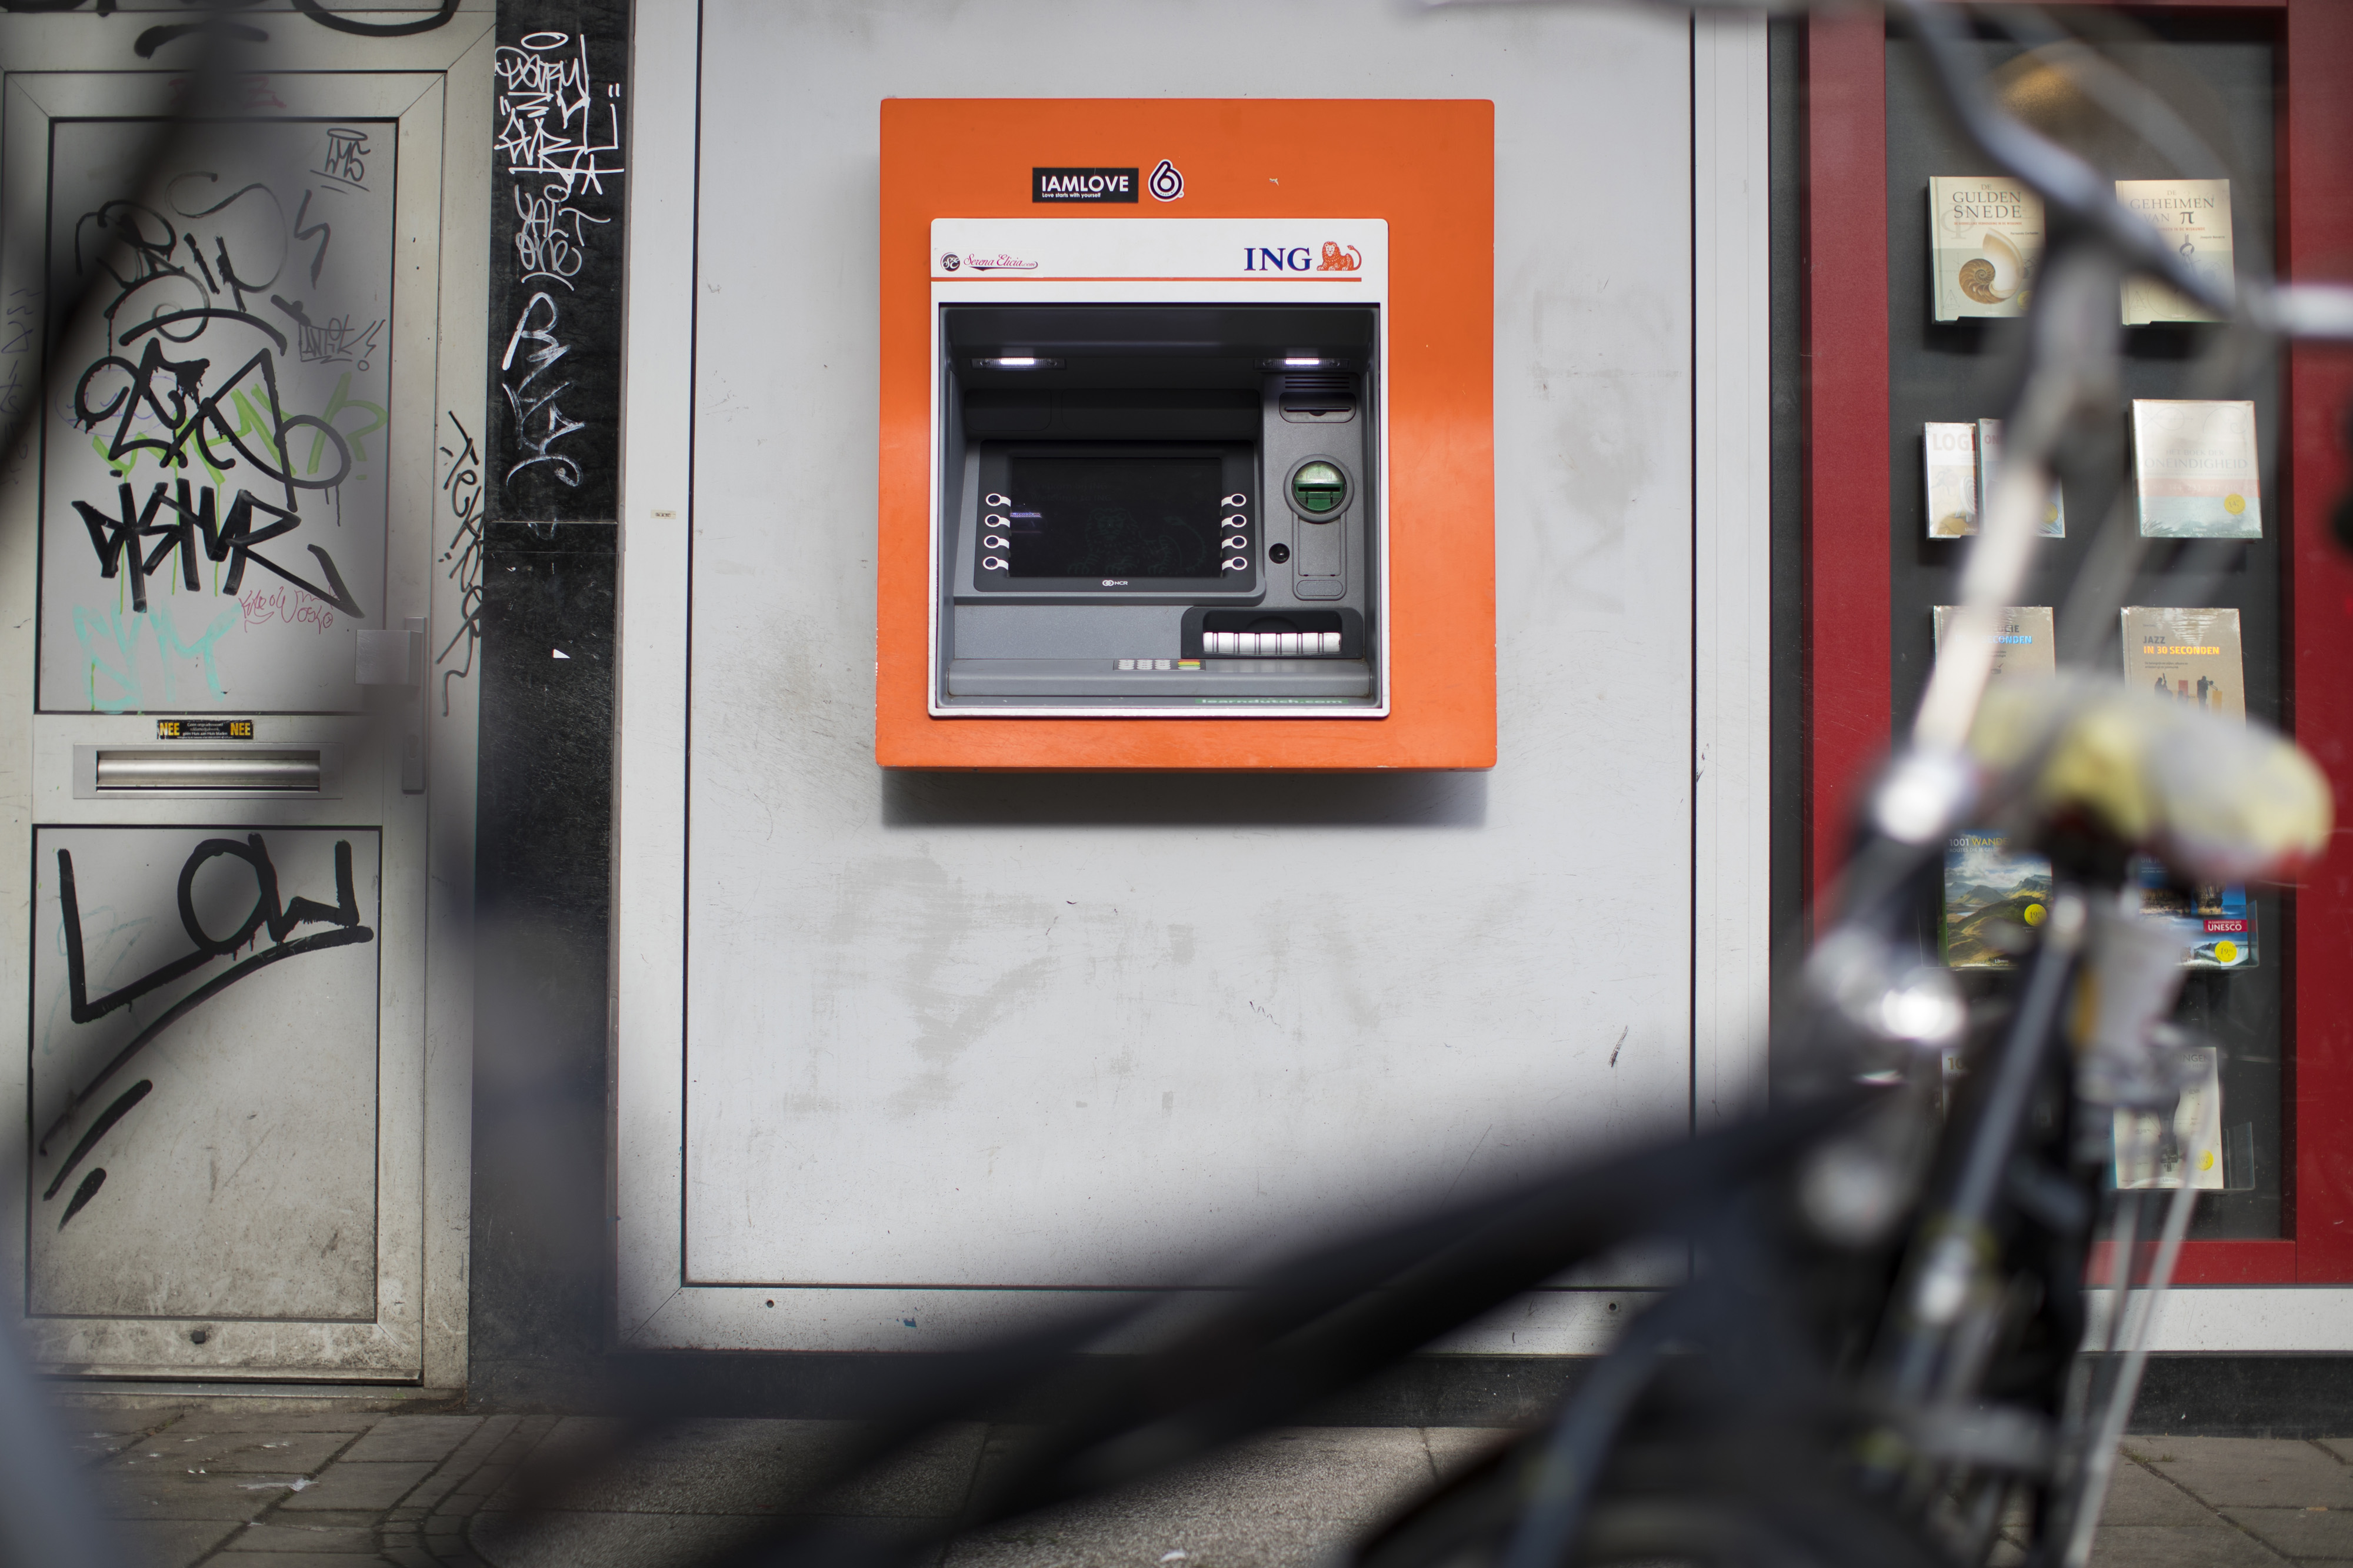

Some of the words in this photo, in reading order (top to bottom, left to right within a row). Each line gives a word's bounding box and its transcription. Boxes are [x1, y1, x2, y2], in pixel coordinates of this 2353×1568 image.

[1042, 176, 1128, 191] IAMLOVE
[1952, 192, 2021, 203] GULDEN
[2130, 198, 2215, 209] GEHEIMEN
[1954, 205, 2021, 218] SNEDE
[964, 253, 994, 266] Serena
[1244, 248, 1312, 271] ING
[2145, 458, 2248, 469] ONEINDIGHEID
[2143, 636, 2165, 644] JAZZ
[2144, 646, 2154, 654] IN
[2157, 646, 2168, 654] 30
[2169, 646, 2220, 654] SECONDEN
[159, 722, 179, 735] NEE
[231, 722, 251, 735] NEE
[1949, 838, 1969, 846] 1001
